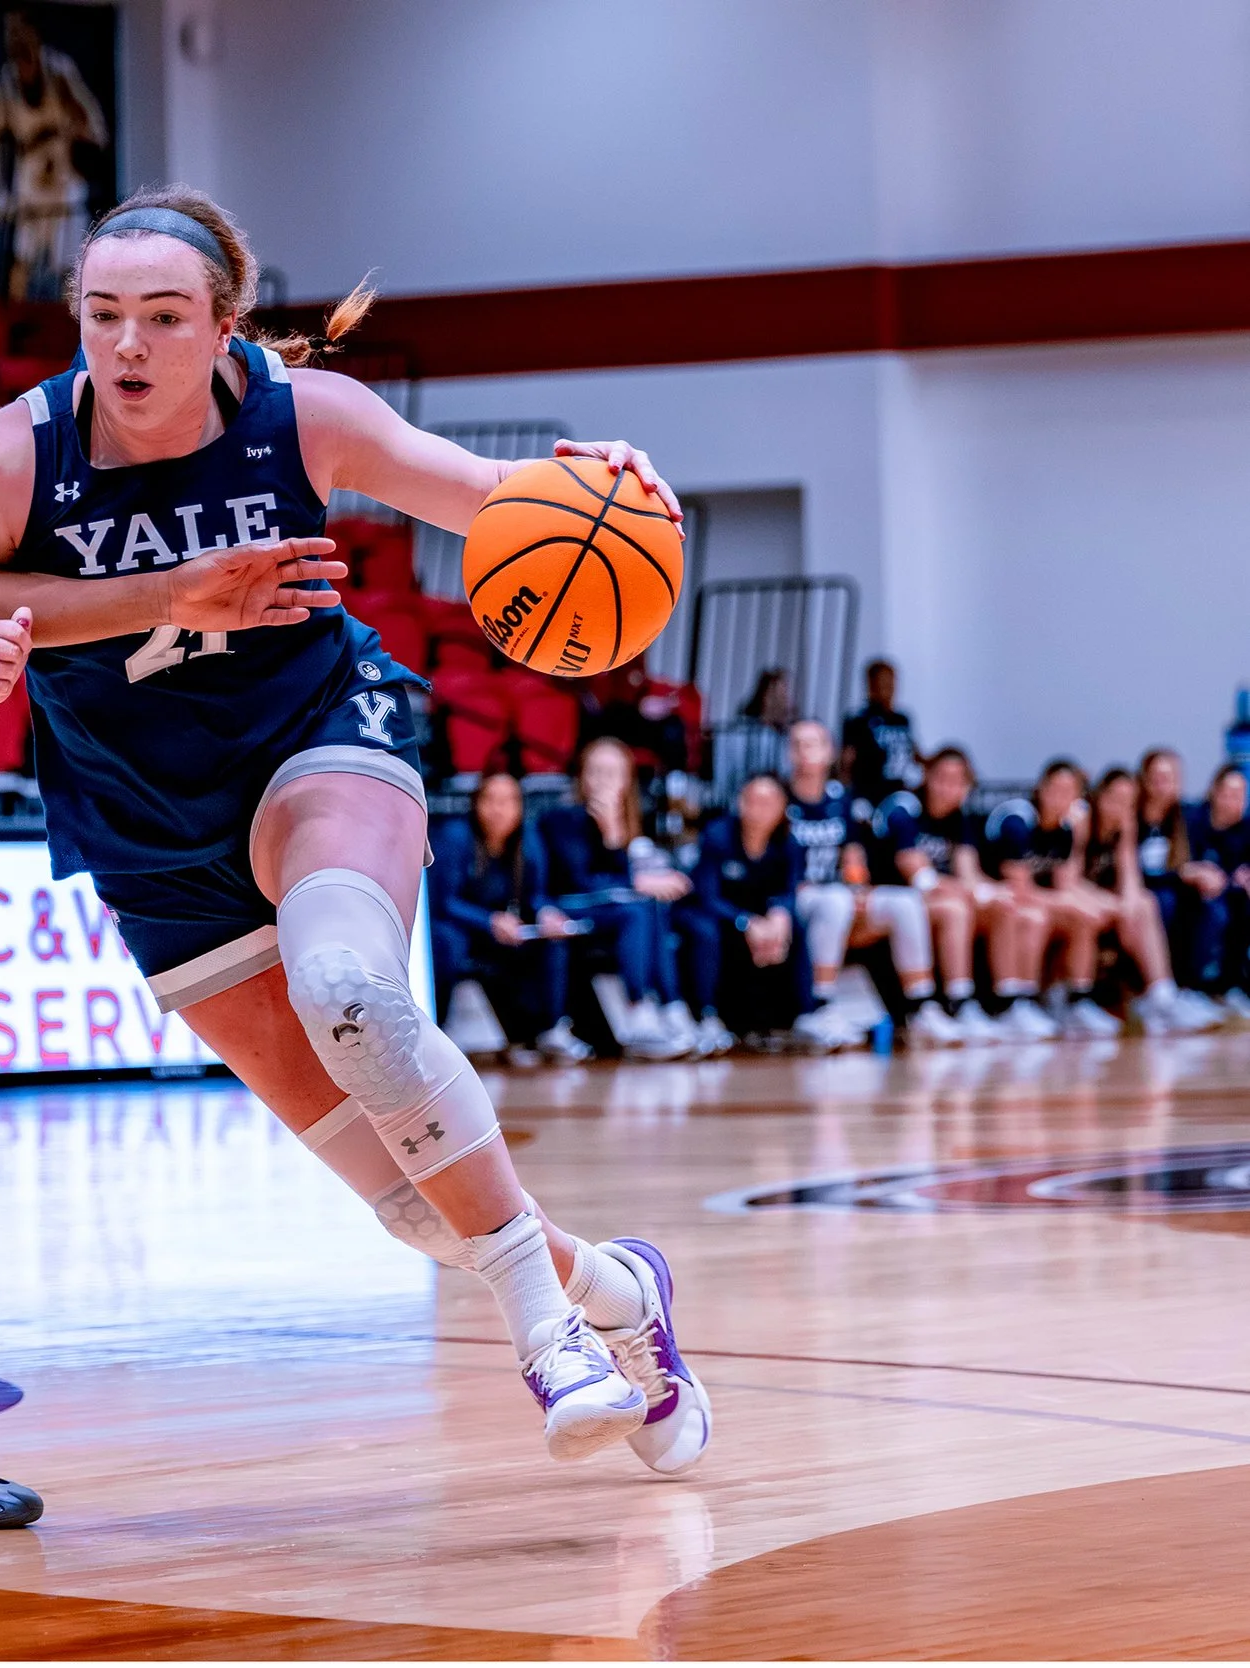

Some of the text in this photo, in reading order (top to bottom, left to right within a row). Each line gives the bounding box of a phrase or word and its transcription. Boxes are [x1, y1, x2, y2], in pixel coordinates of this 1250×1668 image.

[245, 446, 264, 459] Ivy
[54, 493, 280, 575] YALE
[482, 586, 543, 650] ilson
[569, 611, 584, 639] NXT
[350, 691, 397, 746] Y
